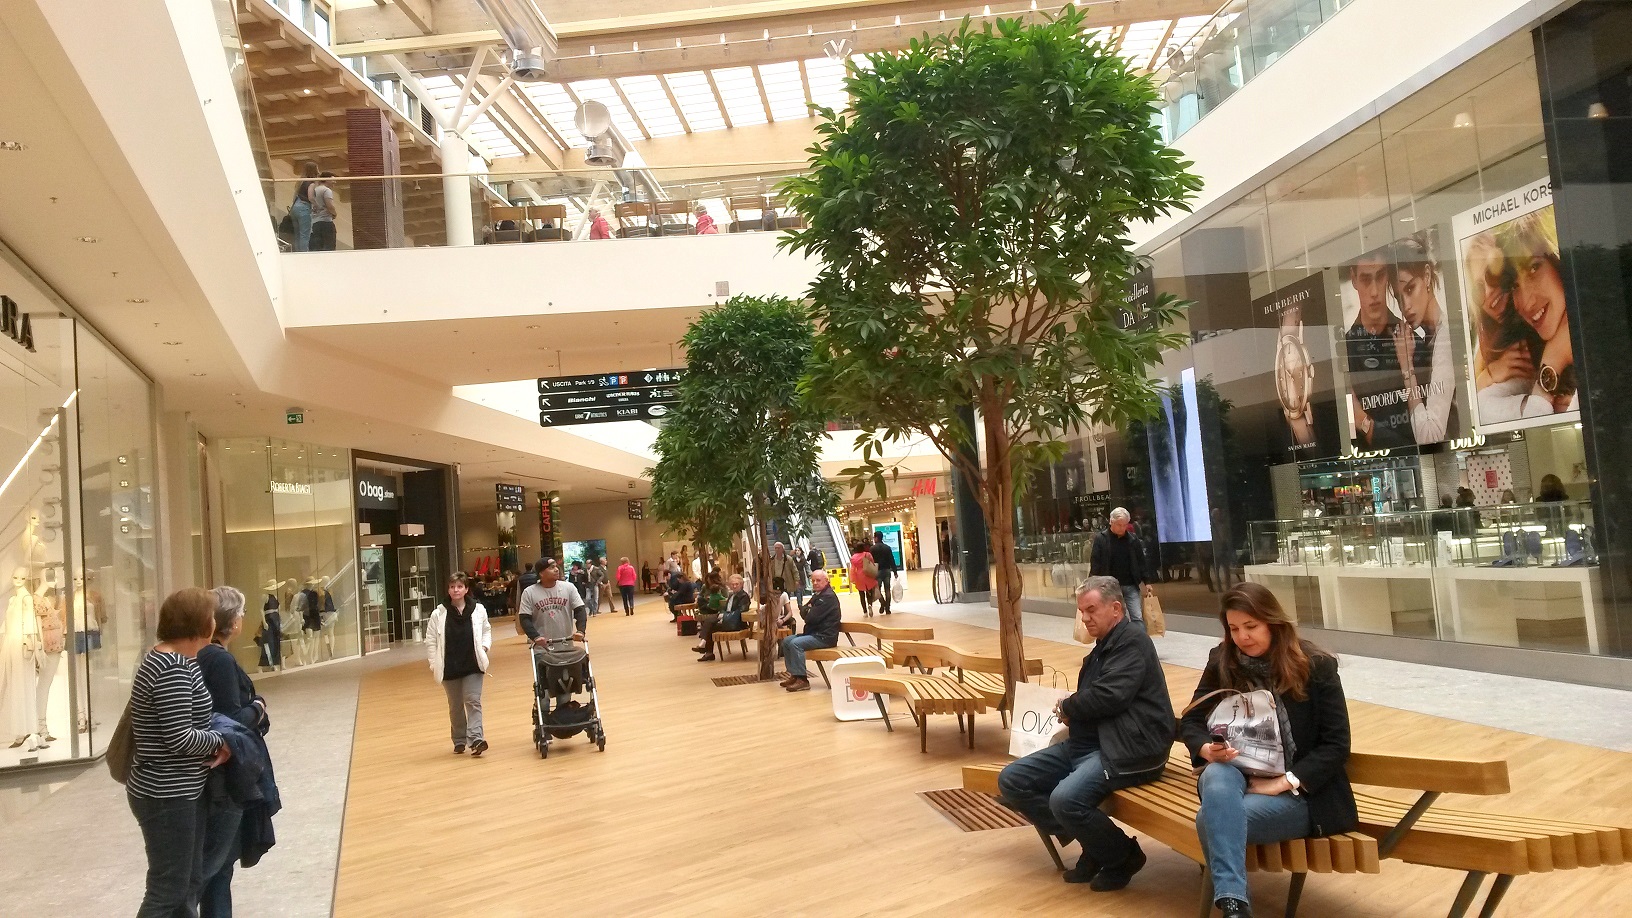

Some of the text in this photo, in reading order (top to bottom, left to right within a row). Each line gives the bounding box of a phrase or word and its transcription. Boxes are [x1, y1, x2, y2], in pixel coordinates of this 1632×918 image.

[1473, 182, 1553, 225] MICHAEL KORS
[1264, 288, 1311, 315] BURBERRY
[1361, 381, 1445, 411] EMPORIO ARMANI
[270, 481, 295, 493] ROBERTA
[360, 481, 367, 496] O
[367, 481, 384, 501] bag
[911, 477, 937, 497] H&M
[534, 597, 568, 610] HOUSTON
[1022, 710, 1058, 735] OVS
